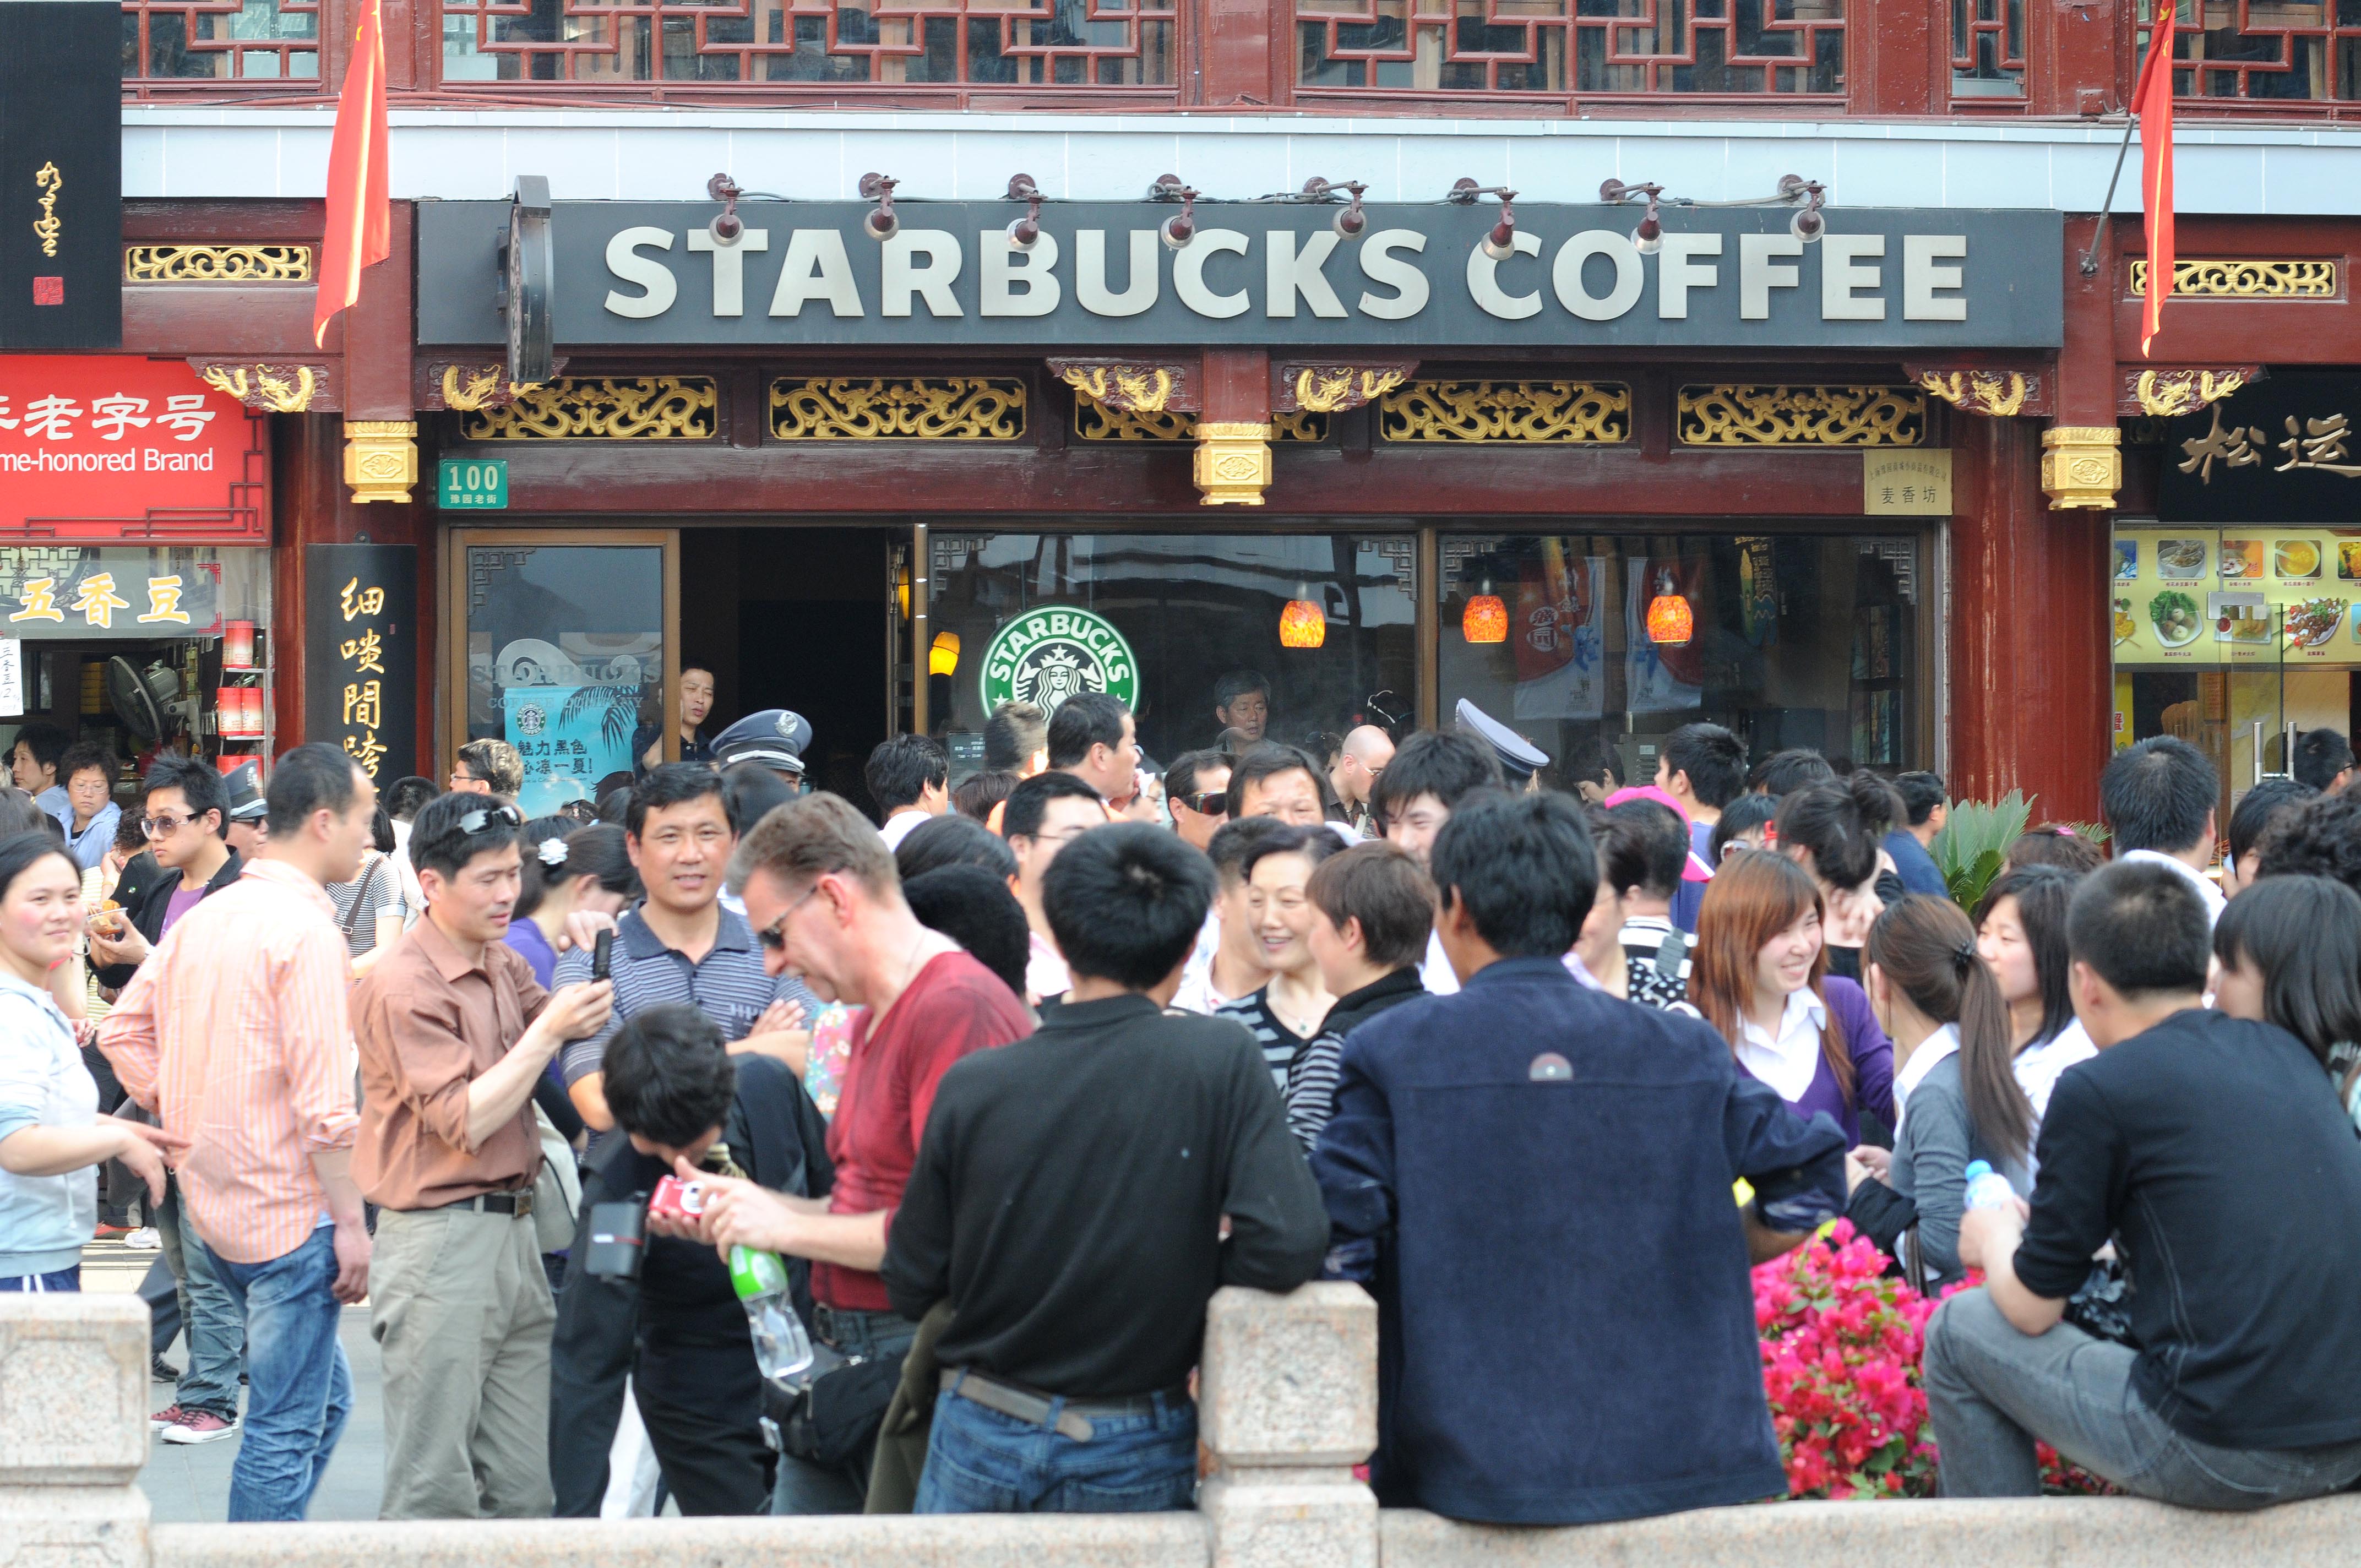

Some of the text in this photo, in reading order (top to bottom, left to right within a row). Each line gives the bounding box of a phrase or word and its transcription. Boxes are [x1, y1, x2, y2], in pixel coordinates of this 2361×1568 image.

[604, 226, 1967, 320] STARBUCKS COFFEE
[144, 448, 213, 471] Brand
[448, 465, 498, 491] 100
[450, 494, 497, 504] 豫园老街
[1881, 486, 1937, 505] 麦香坊
[9, 572, 191, 629] 五香豆
[989, 613, 1130, 683] STARBUCKS
